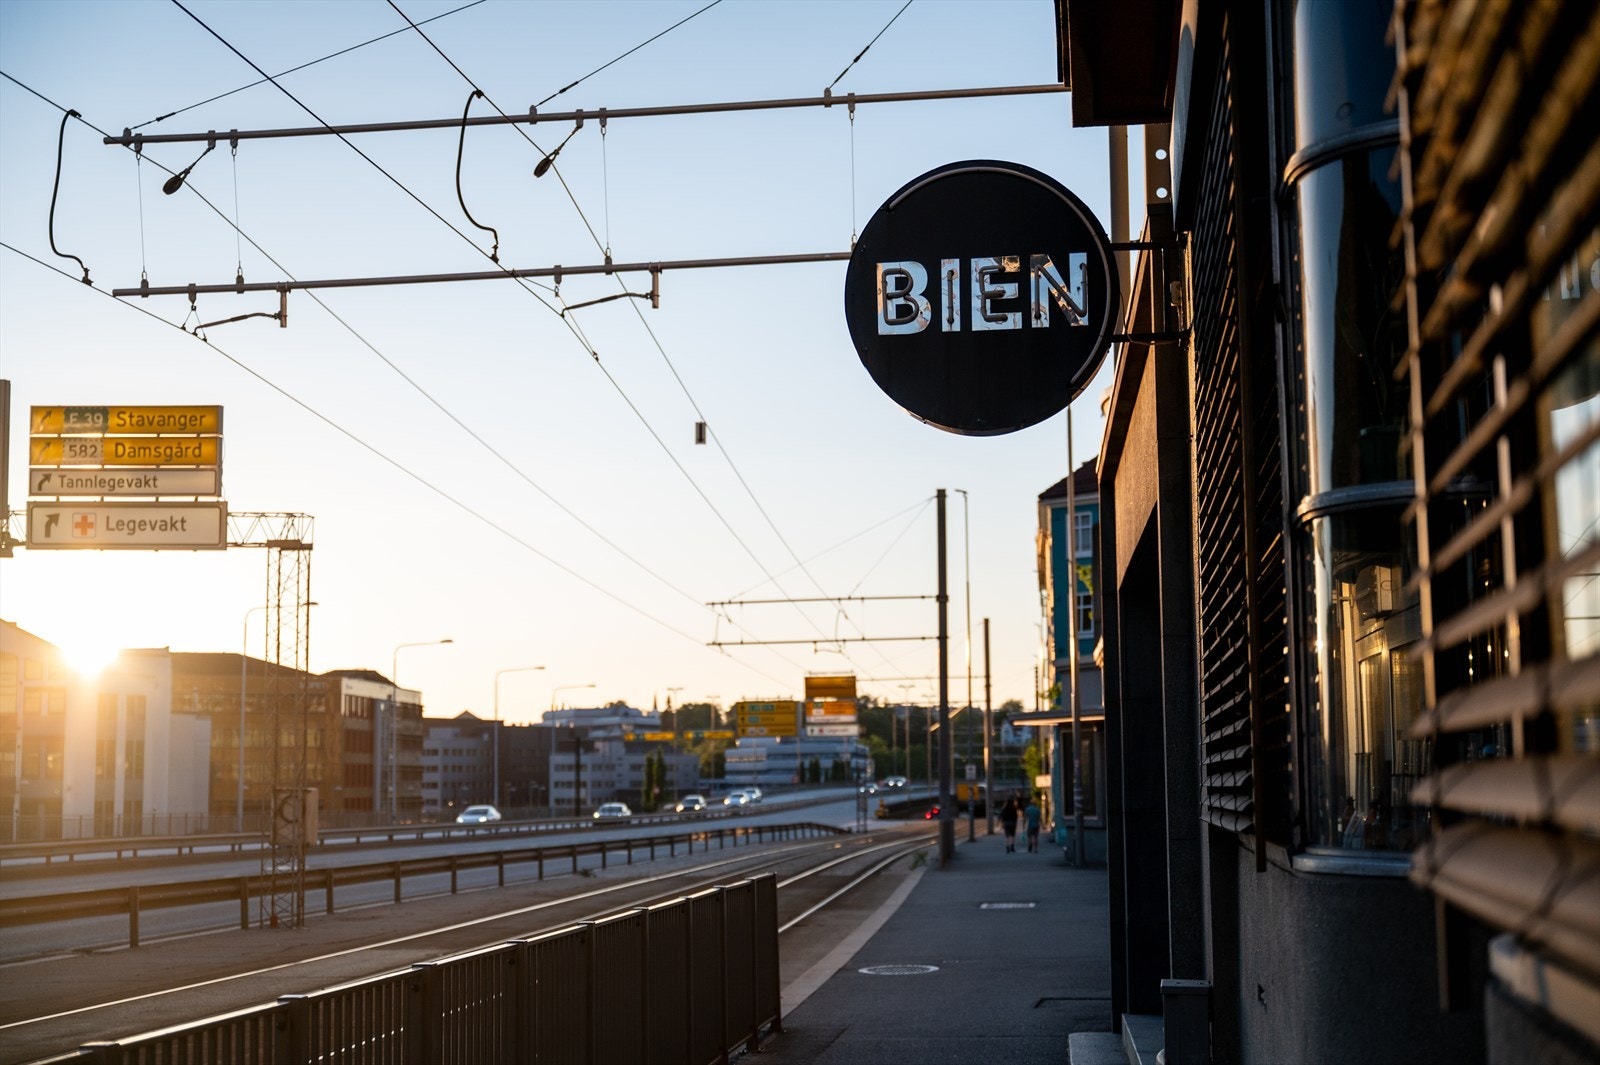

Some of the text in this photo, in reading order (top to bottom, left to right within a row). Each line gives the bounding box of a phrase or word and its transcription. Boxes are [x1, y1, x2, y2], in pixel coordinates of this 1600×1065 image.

[876, 252, 1089, 336] BIEN
[84, 412, 103, 427] 39
[116, 411, 206, 431] Stavanger
[68, 442, 202, 462] 582 Damsgård
[58, 474, 158, 491] Tannlegevakt
[106, 515, 187, 536] Legevakt
